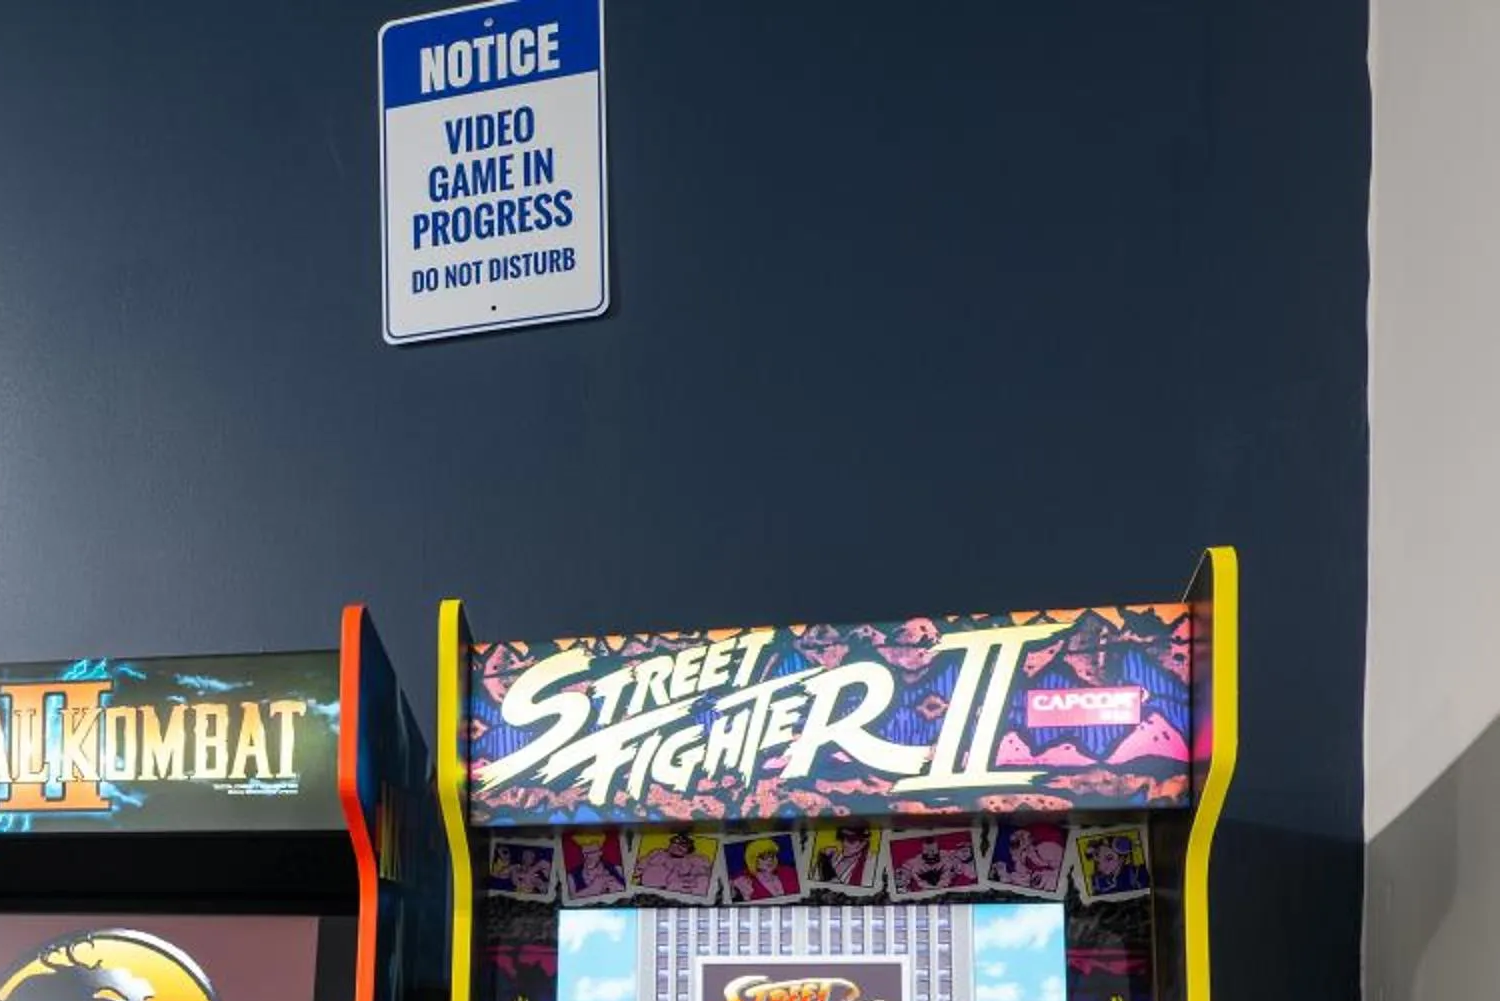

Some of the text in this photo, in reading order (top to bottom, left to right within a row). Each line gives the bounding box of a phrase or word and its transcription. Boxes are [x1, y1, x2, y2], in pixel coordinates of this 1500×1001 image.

[419, 22, 560, 95] NOTICE
[445, 105, 535, 155] VIDEO
[428, 148, 554, 202] GAME IN
[412, 189, 574, 250] PROGRESS
[411, 247, 577, 294] DO NOT DISTURB
[59, 699, 308, 783] KOMBAT
[473, 626, 776, 794] STREET
[530, 622, 1076, 806] FIGHTER II
